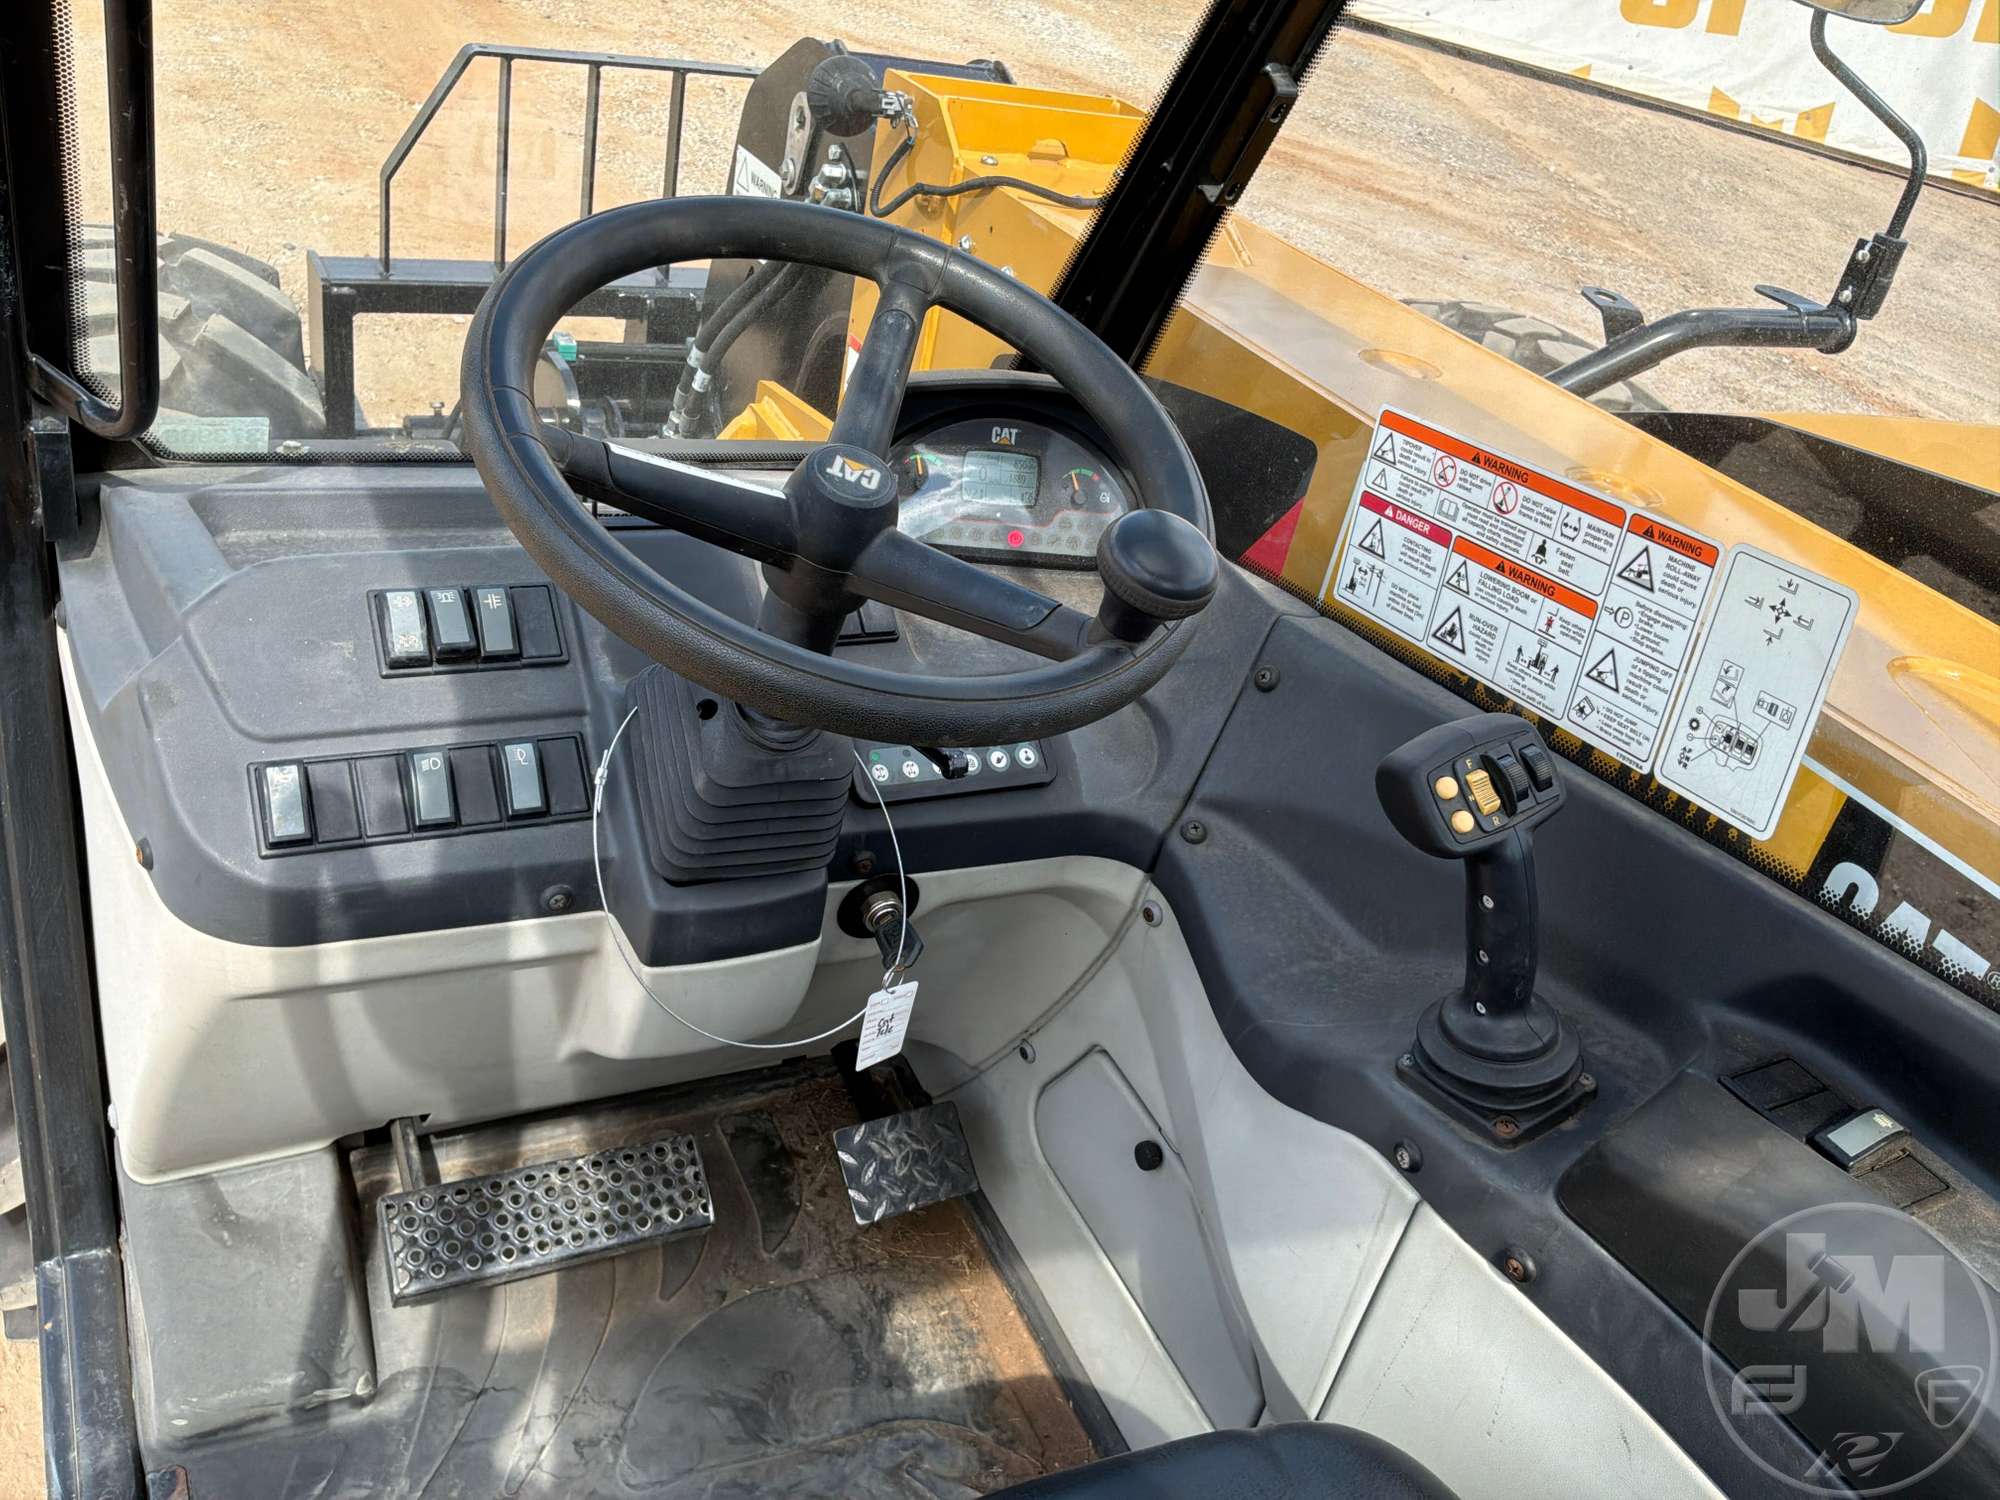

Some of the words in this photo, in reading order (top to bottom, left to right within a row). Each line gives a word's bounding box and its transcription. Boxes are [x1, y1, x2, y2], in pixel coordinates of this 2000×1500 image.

[992, 426, 1018, 446] CAT
[1398, 452, 1410, 461] death
[1400, 446, 1413, 455] could
[1413, 451, 1426, 461] result
[826, 454, 881, 490] CAT
[1482, 455, 1529, 484] WARNING
[1458, 476, 1468, 484] with
[1469, 480, 1483, 490] boom
[1461, 502, 1481, 516] Operator
[1481, 511, 1493, 521] must
[1500, 519, 1516, 531] trained
[1518, 509, 1532, 520] frame
[1520, 503, 1534, 513] boom
[1535, 509, 1552, 521] unless
[1543, 505, 1556, 514] raise
[1394, 509, 1430, 534] DANGER
[1498, 526, 1524, 542] understand
[1584, 531, 1602, 544] proper
[1603, 538, 1613, 547] tire
[1586, 523, 1614, 540] MAINTAIN
[1401, 542, 1418, 555] POWER
[1418, 551, 1431, 562] LINES
[1403, 536, 1431, 554] CONTACTING
[1656, 529, 1703, 558] WARNING
[1555, 547, 1576, 561] Fasten
[1407, 554, 1419, 563] result
[1425, 563, 1436, 572] death
[1560, 558, 1573, 569] seat
[1667, 555, 1696, 571] MACHINE
[1662, 570, 1679, 582] could
[1679, 578, 1697, 590] cause
[1665, 562, 1701, 582] ROLL-AWAY
[1479, 571, 1510, 591] LOWERING
[1511, 586, 1530, 600] BOOM
[1507, 566, 1556, 597] WARNING
[1660, 578, 1676, 590] death
[1477, 578, 1502, 595] FALLING
[1502, 591, 1519, 604] LOAD
[1657, 586, 1678, 599] serious
[1497, 596, 1514, 610] causing
[1515, 605, 1527, 615] death
[1635, 601, 1653, 613] Before
[1468, 613, 1498, 633] RUN-OVER
[1472, 623, 1496, 640] HAZARD
[1558, 616, 1570, 626] Keep
[1570, 622, 1586, 633] others
[1559, 623, 1572, 633] away
[1572, 630, 1584, 639] while
[1468, 629, 1480, 639] could
[1480, 636, 1493, 646] cause
[1653, 632, 1669, 643] boom
[1633, 655, 1660, 673] JUMPING
[1506, 661, 1517, 671] Keep
[1518, 667, 1531, 678] others
[1531, 675, 1543, 685] away
[1641, 669, 1662, 683] tipping
[1623, 685, 1639, 696] death
[1626, 678, 1643, 690] result
[1628, 670, 1652, 686] machine
[1652, 682, 1668, 694] could
[1621, 692, 1641, 706] serious
[1603, 713, 1616, 723] KEEP
[1617, 720, 1629, 730] SEAT
[1629, 727, 1641, 737] BELT
[1465, 759, 1473, 769] F
[1492, 816, 1501, 826] R
